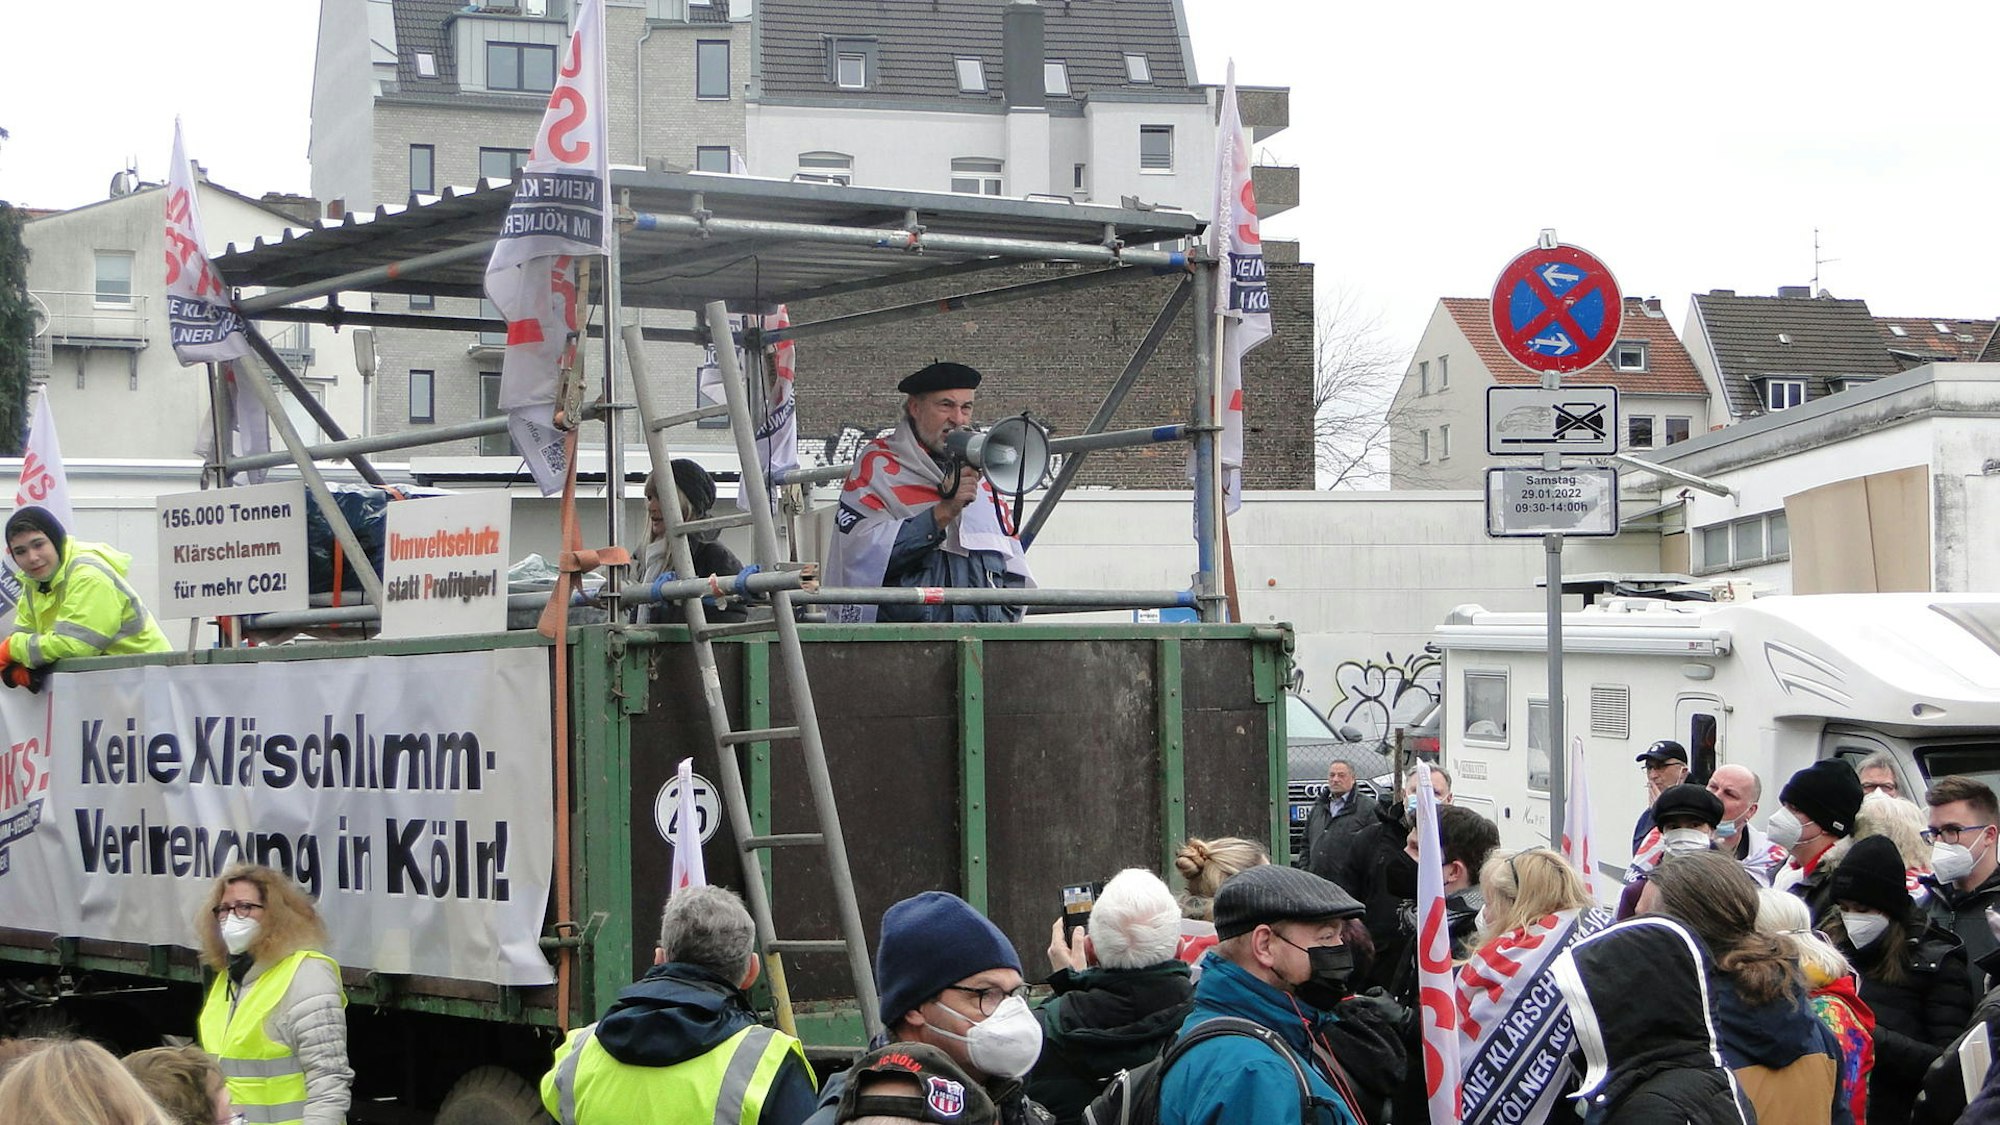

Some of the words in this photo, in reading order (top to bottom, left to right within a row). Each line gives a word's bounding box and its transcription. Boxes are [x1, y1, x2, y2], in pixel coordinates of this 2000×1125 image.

[1521, 488, 1581, 499] 29.01.2022
[1526, 475, 1576, 486] Samstag
[162, 504, 225, 529] 156.000
[229, 503, 292, 522] Tonnen
[1515, 502, 1588, 513] 09:30-14:00h
[173, 540, 282, 564] Klärschlamm
[389, 525, 500, 562] Umweltschutz
[174, 580, 197, 599] für
[201, 577, 243, 597] mehr
[247, 572, 287, 595] CO2!
[387, 574, 420, 602] statt
[423, 568, 498, 604] Profitgier!
[337, 815, 373, 891] in
[385, 817, 510, 902] Köln!
